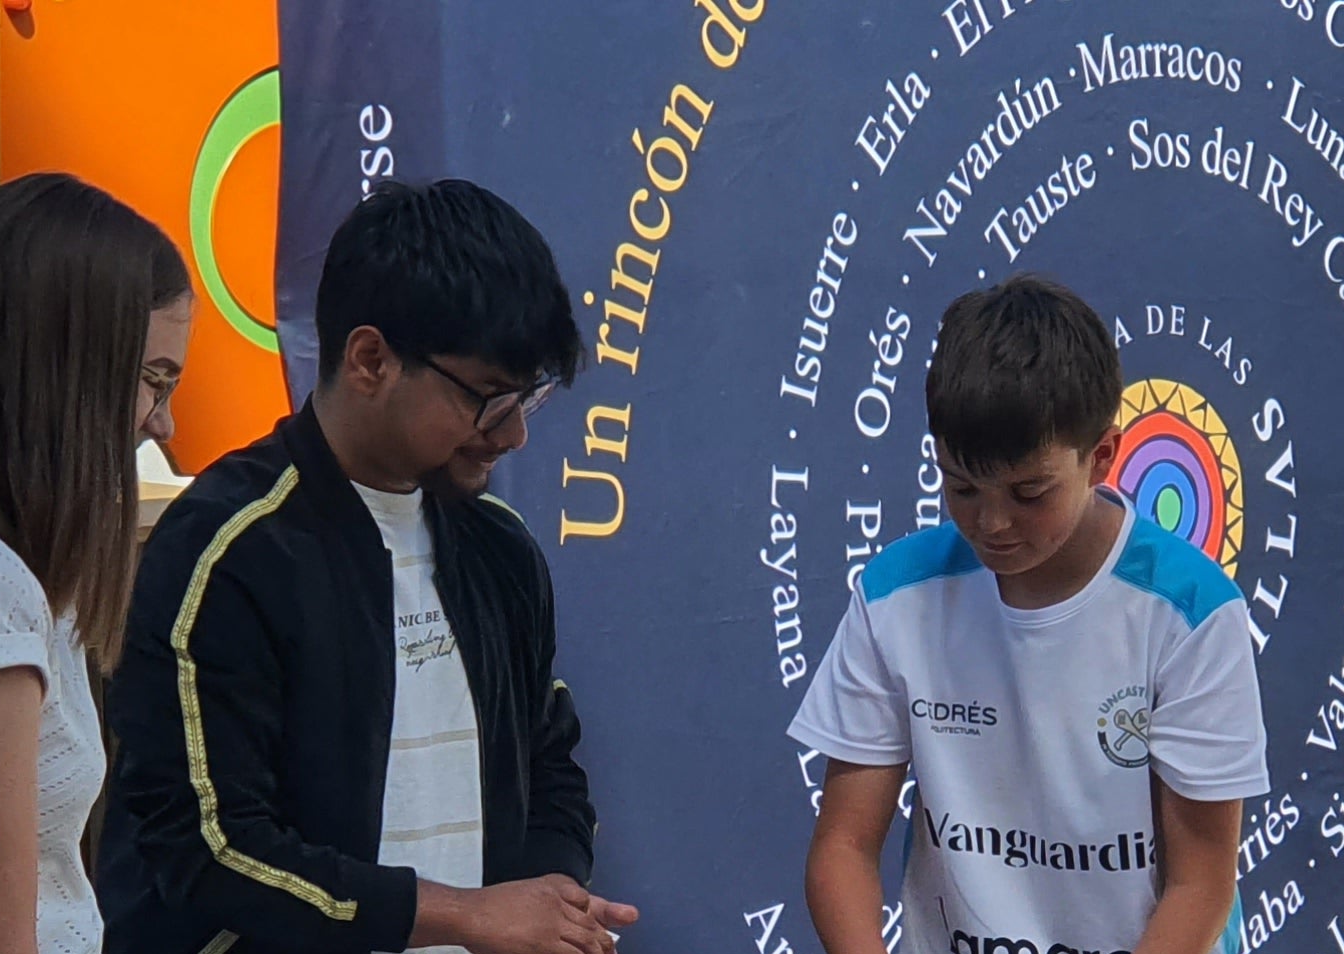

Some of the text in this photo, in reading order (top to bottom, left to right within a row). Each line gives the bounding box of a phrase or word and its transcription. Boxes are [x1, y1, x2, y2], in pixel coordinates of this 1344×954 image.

[583, 83, 714, 374] rincón
[779, 211, 858, 408] Isuerre
[854, 71, 931, 177] Erla
[854, 306, 911, 438] Orés
[902, 77, 1063, 268] Navardún
[1076, 33, 1243, 93] Marracos
[983, 152, 1097, 264] Tauste
[1128, 118, 1191, 171] Sos
[1201, 126, 1255, 190] del
[1257, 154, 1324, 248] Rey
[1145, 305, 1185, 336] DE
[1198, 316, 1253, 386] LAS
[559, 403, 632, 545] Un
[760, 464, 808, 688] Layana
[1247, 398, 1297, 654] ILLAS
[396, 612, 424, 629] NIC
